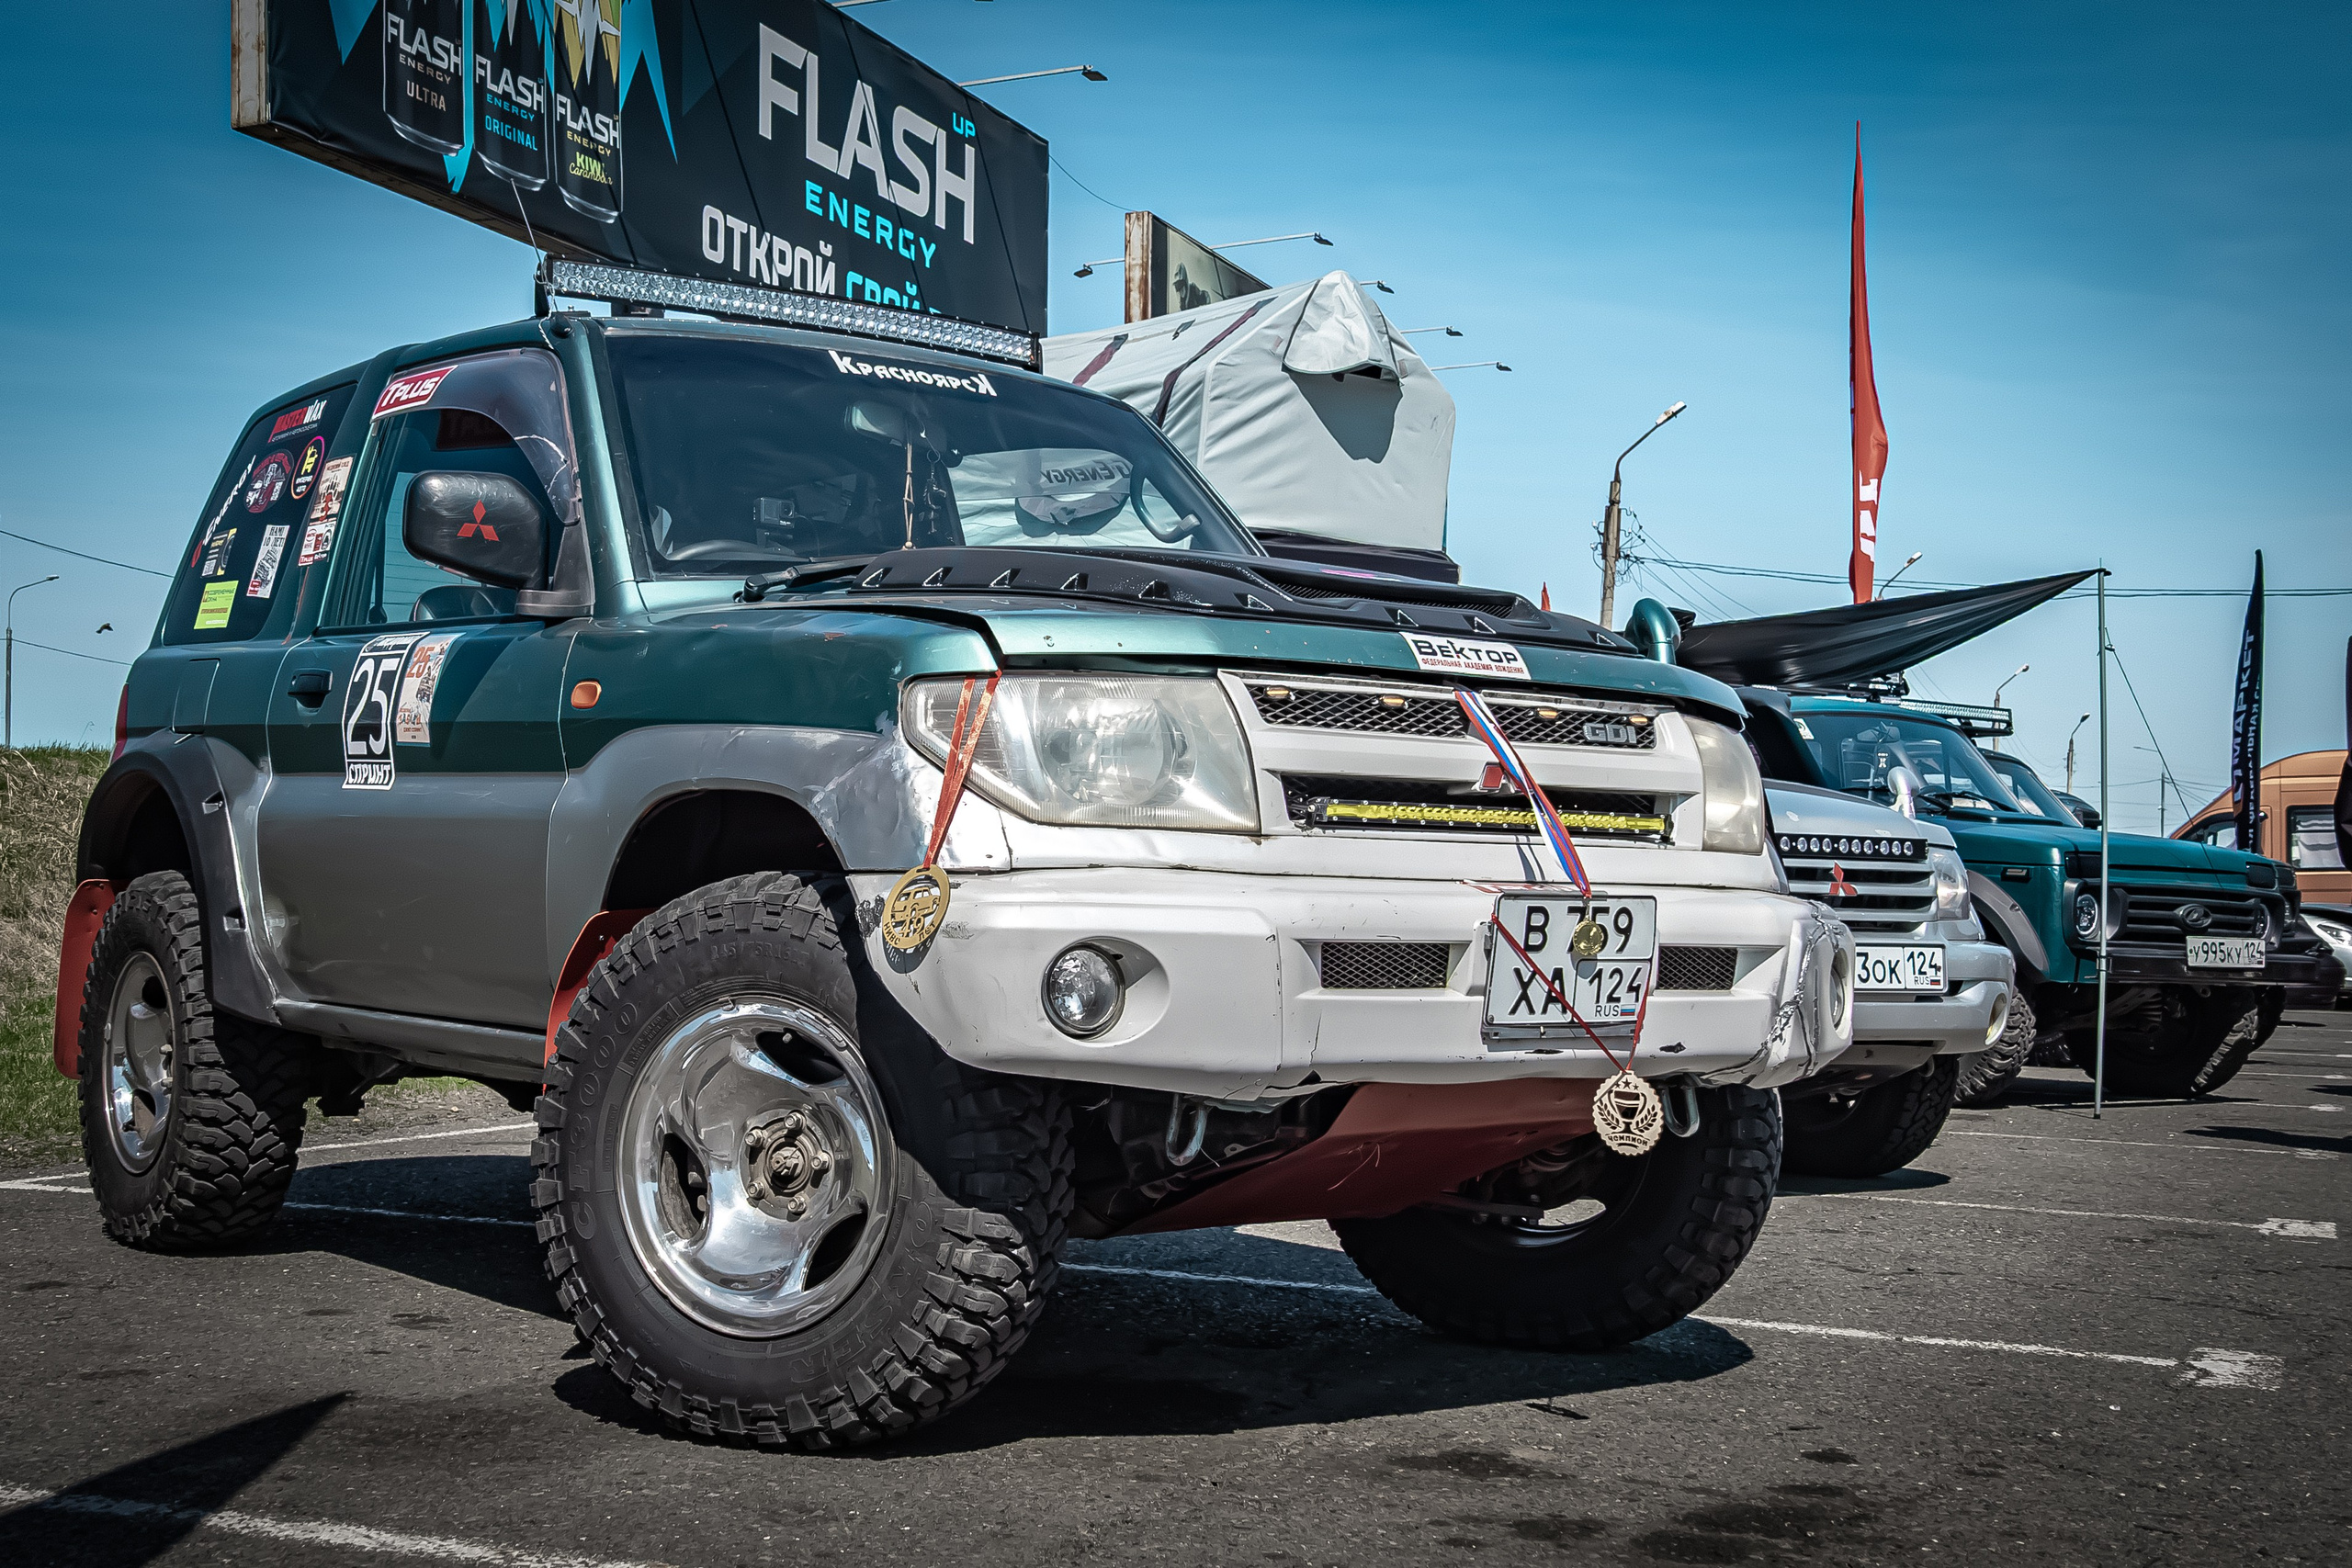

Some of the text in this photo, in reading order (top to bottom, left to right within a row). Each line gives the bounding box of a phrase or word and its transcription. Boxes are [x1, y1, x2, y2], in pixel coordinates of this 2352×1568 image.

[388, 12, 461, 76] FLASH
[400, 53, 451, 85] ENERGY
[476, 53, 544, 114] FLASH
[407, 80, 446, 111] ULTRA
[486, 93, 535, 121] ENERGY
[485, 115, 538, 152] ORIGINAL
[557, 93, 619, 149] FLASH
[759, 22, 975, 245] FLASH
[952, 112, 976, 139] UP
[805, 180, 937, 268] ENERGY
[702, 204, 836, 296] ОТКРОЙ
[381, 376, 441, 407] TPLUS
[405, 646, 435, 678] 25
[1421, 658, 1525, 674] ФЕДЕРАЛЬНАЯ АКАДЕМИЯ ВОЖДЕНИЯ
[347, 658, 401, 755] 25
[1583, 722, 1637, 744] GDI
[348, 763, 391, 784] СПРИНТ
[1566, 905, 1634, 953] 759
[1906, 951, 1938, 976] 124
[2245, 942, 2263, 958] 124
[1589, 966, 1644, 1005] 124
[1914, 976, 1930, 986] RUS
[1594, 1004, 1620, 1018] RUS
